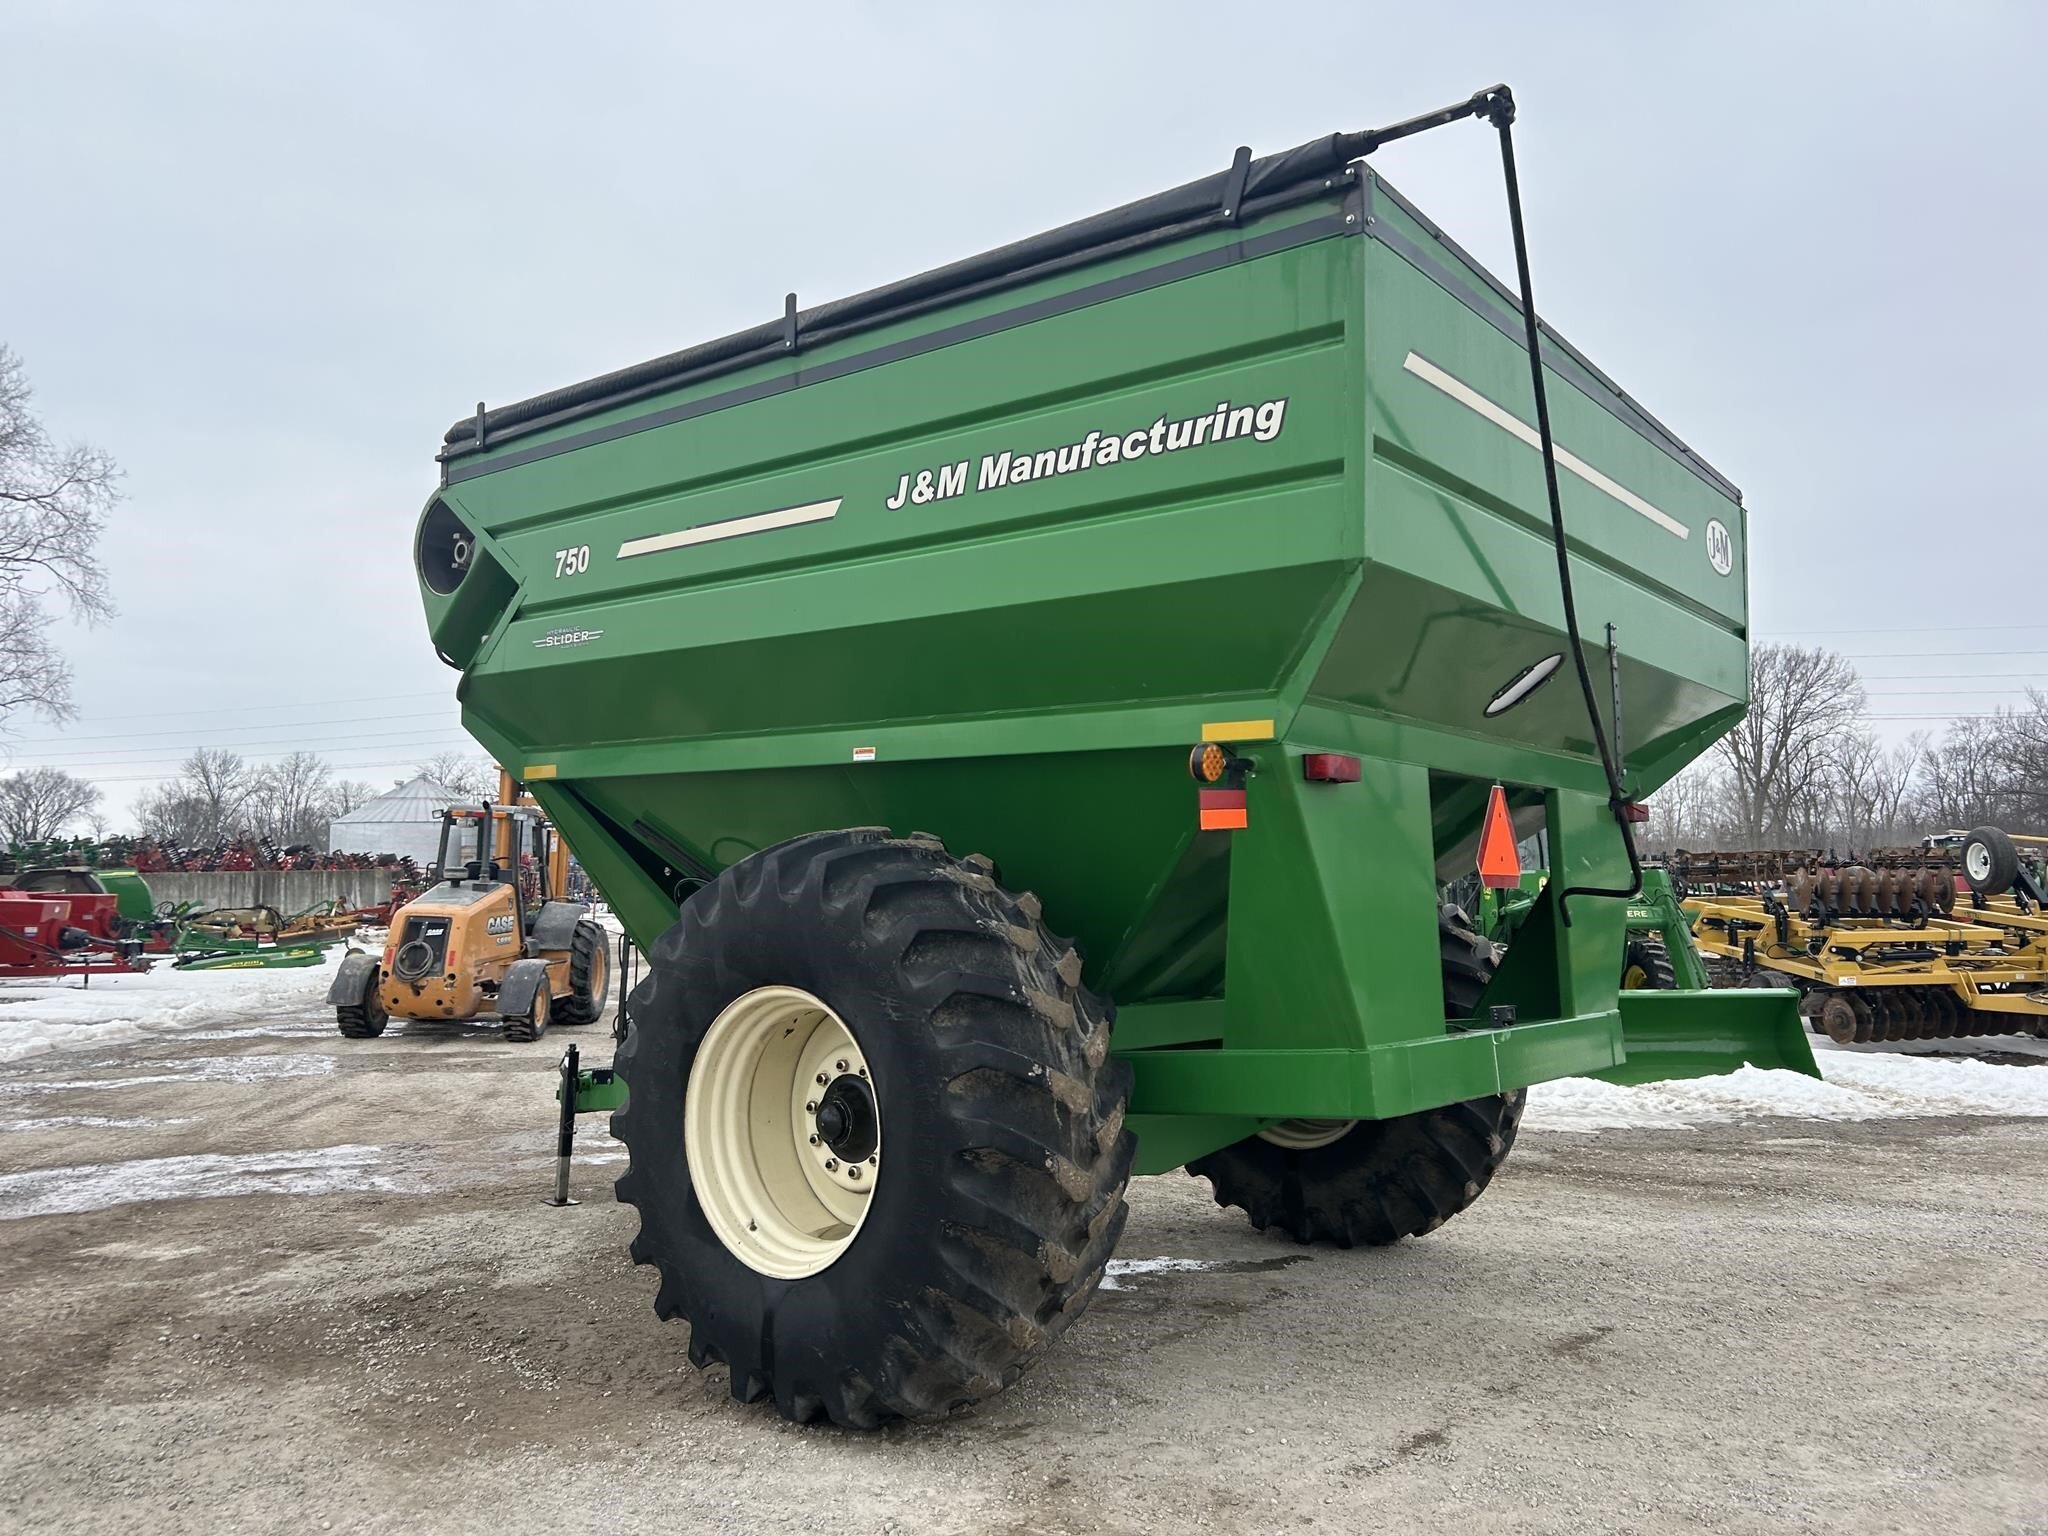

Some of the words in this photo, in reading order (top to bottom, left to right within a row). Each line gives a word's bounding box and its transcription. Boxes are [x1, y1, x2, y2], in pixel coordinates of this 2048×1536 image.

[886, 459, 970, 511] J&M
[977, 397, 1289, 492] Manufacturing
[1708, 526, 1730, 568] J&M
[555, 544, 590, 579] 750
[545, 630, 589, 647] SLIDER
[487, 915, 514, 935] CASE
[1626, 910, 1648, 918] ERE
